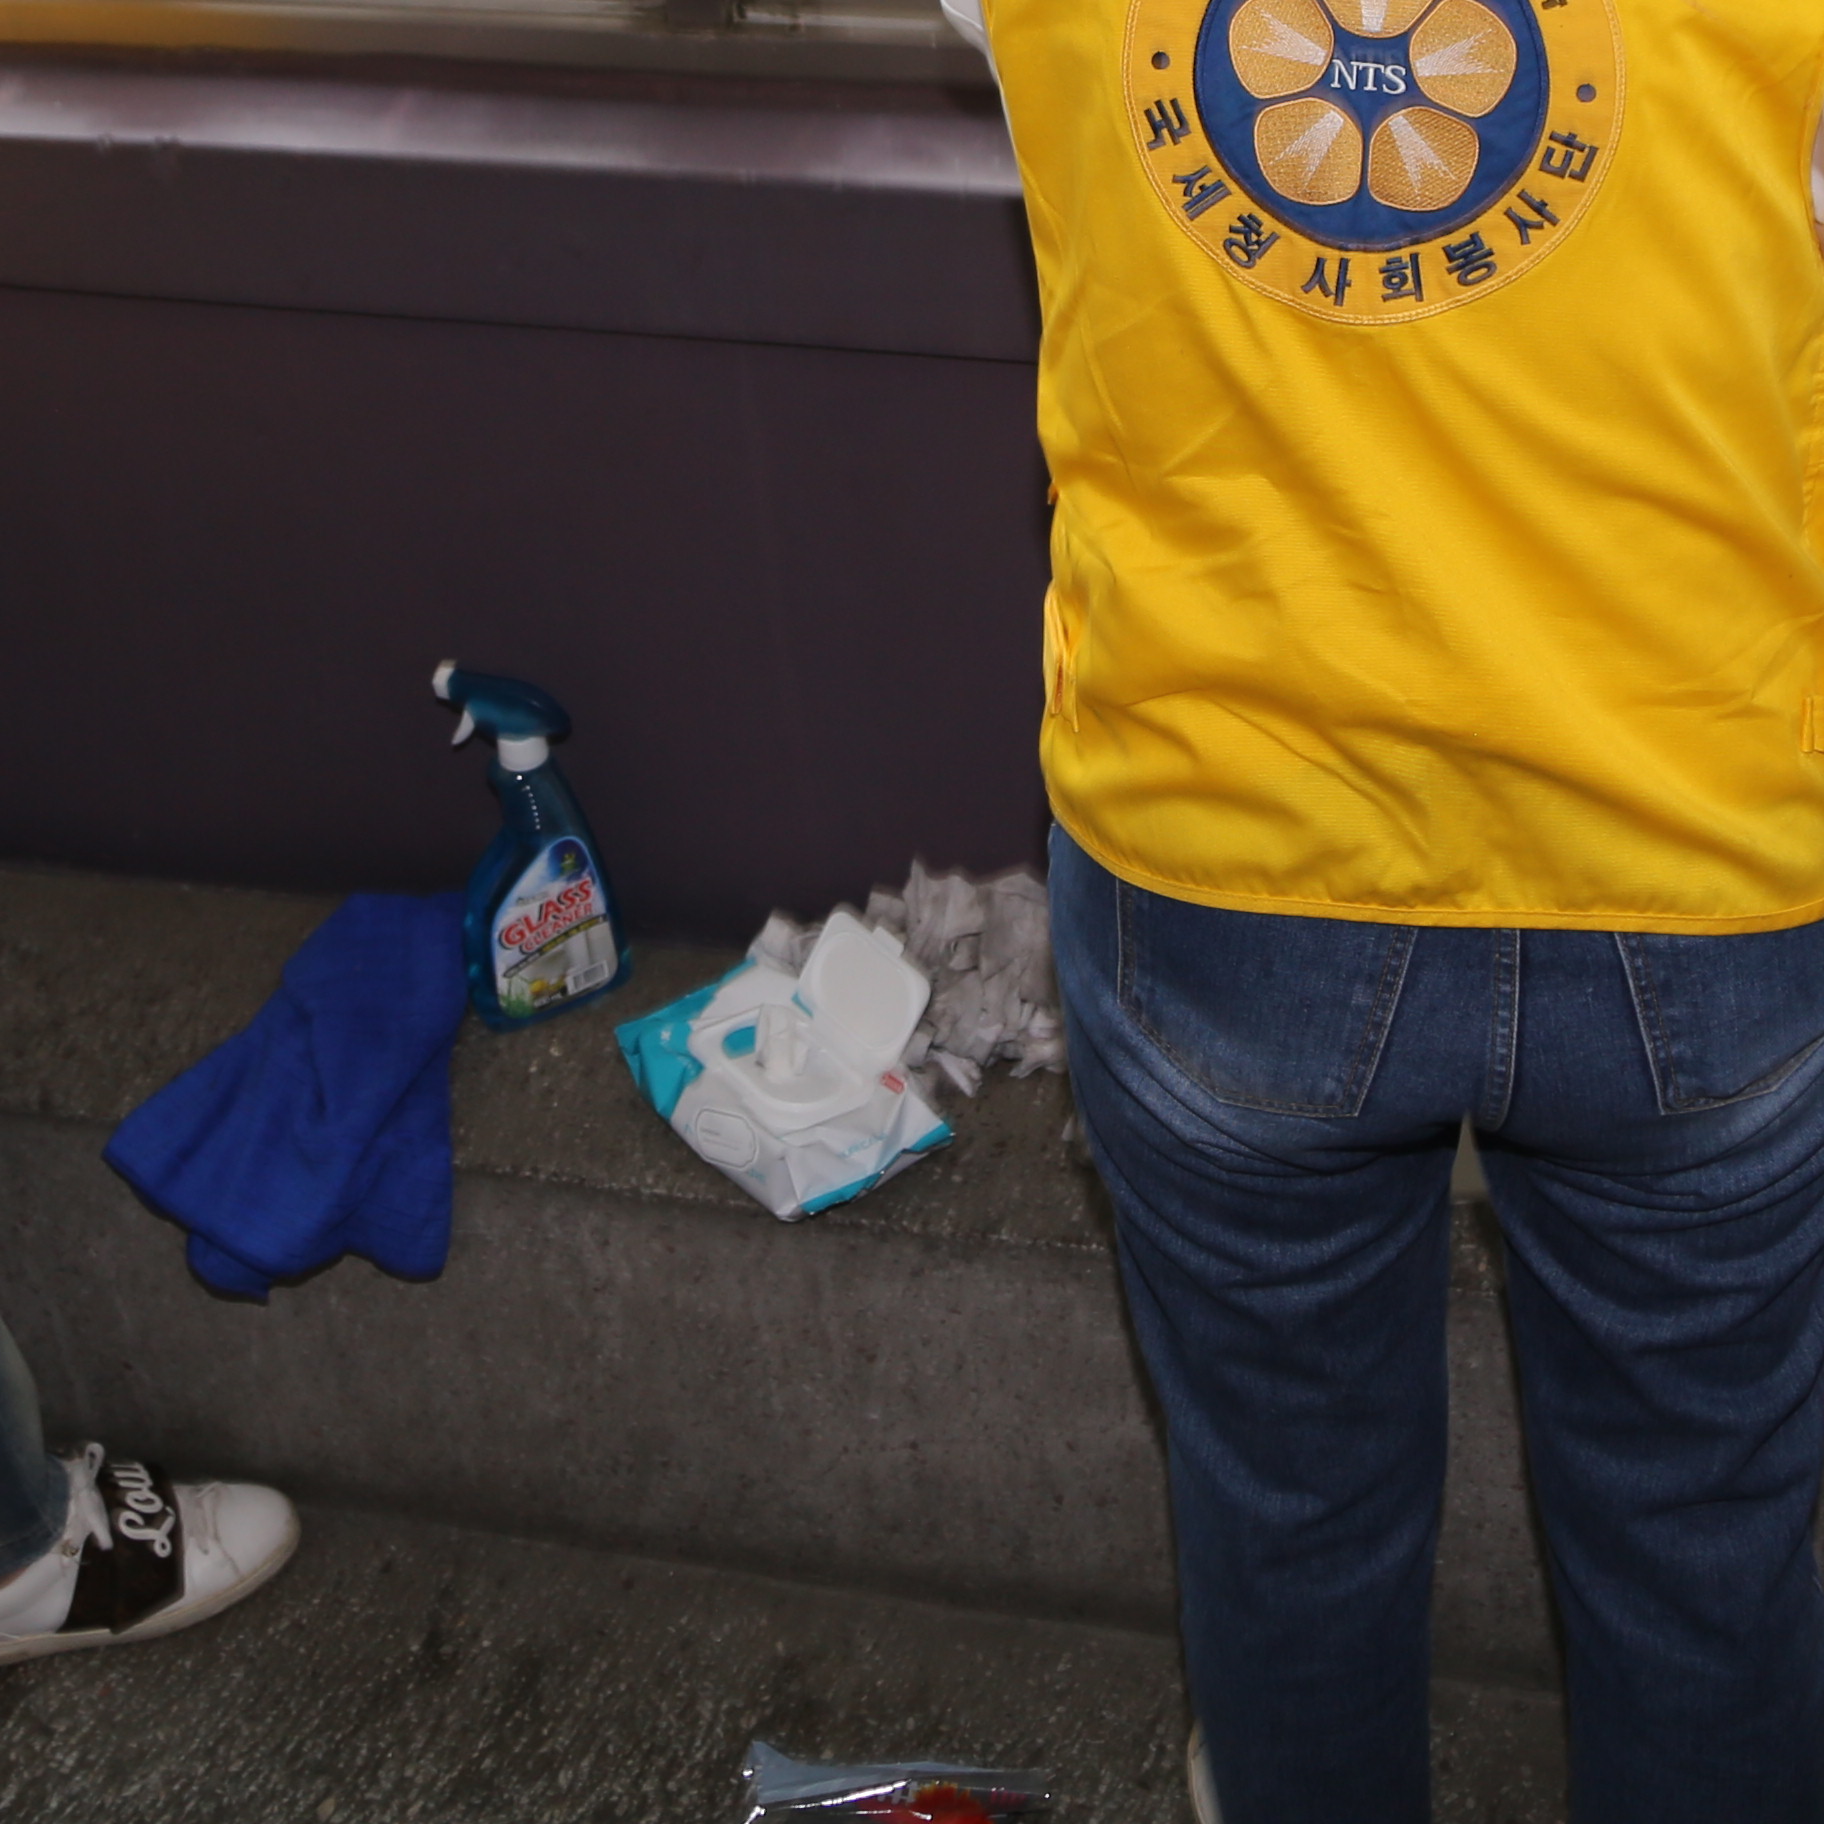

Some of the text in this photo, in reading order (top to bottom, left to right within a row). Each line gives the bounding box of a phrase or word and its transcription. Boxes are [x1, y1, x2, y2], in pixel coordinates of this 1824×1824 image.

[1329, 58, 1408, 95] NTS
[1143, 97, 1599, 307] 국세청 사회봉사단
[500, 879, 593, 949] GLASS
[522, 902, 594, 954] CLEANER
